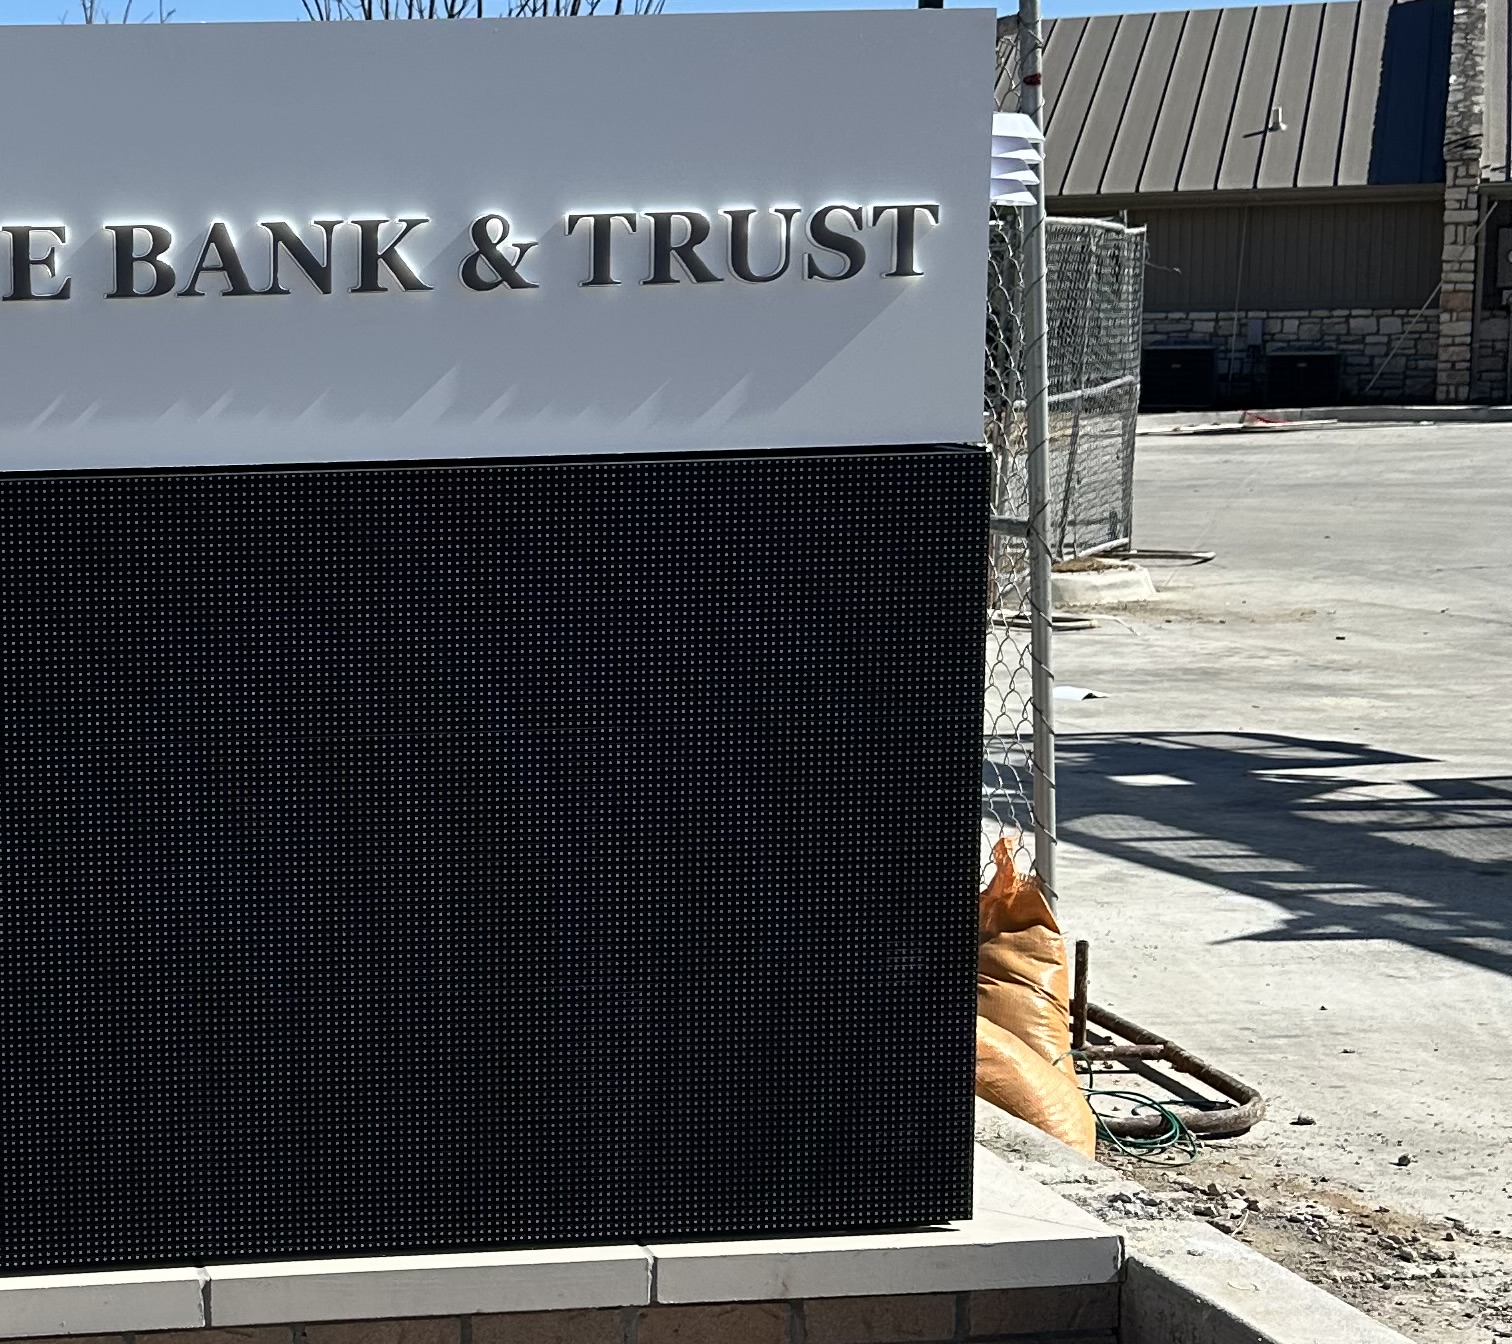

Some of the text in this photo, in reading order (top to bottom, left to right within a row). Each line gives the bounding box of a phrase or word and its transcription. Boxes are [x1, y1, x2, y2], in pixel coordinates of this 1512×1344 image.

[102, 218, 435, 299] BANK
[458, 212, 540, 292] &
[564, 203, 940, 288] TRUST
